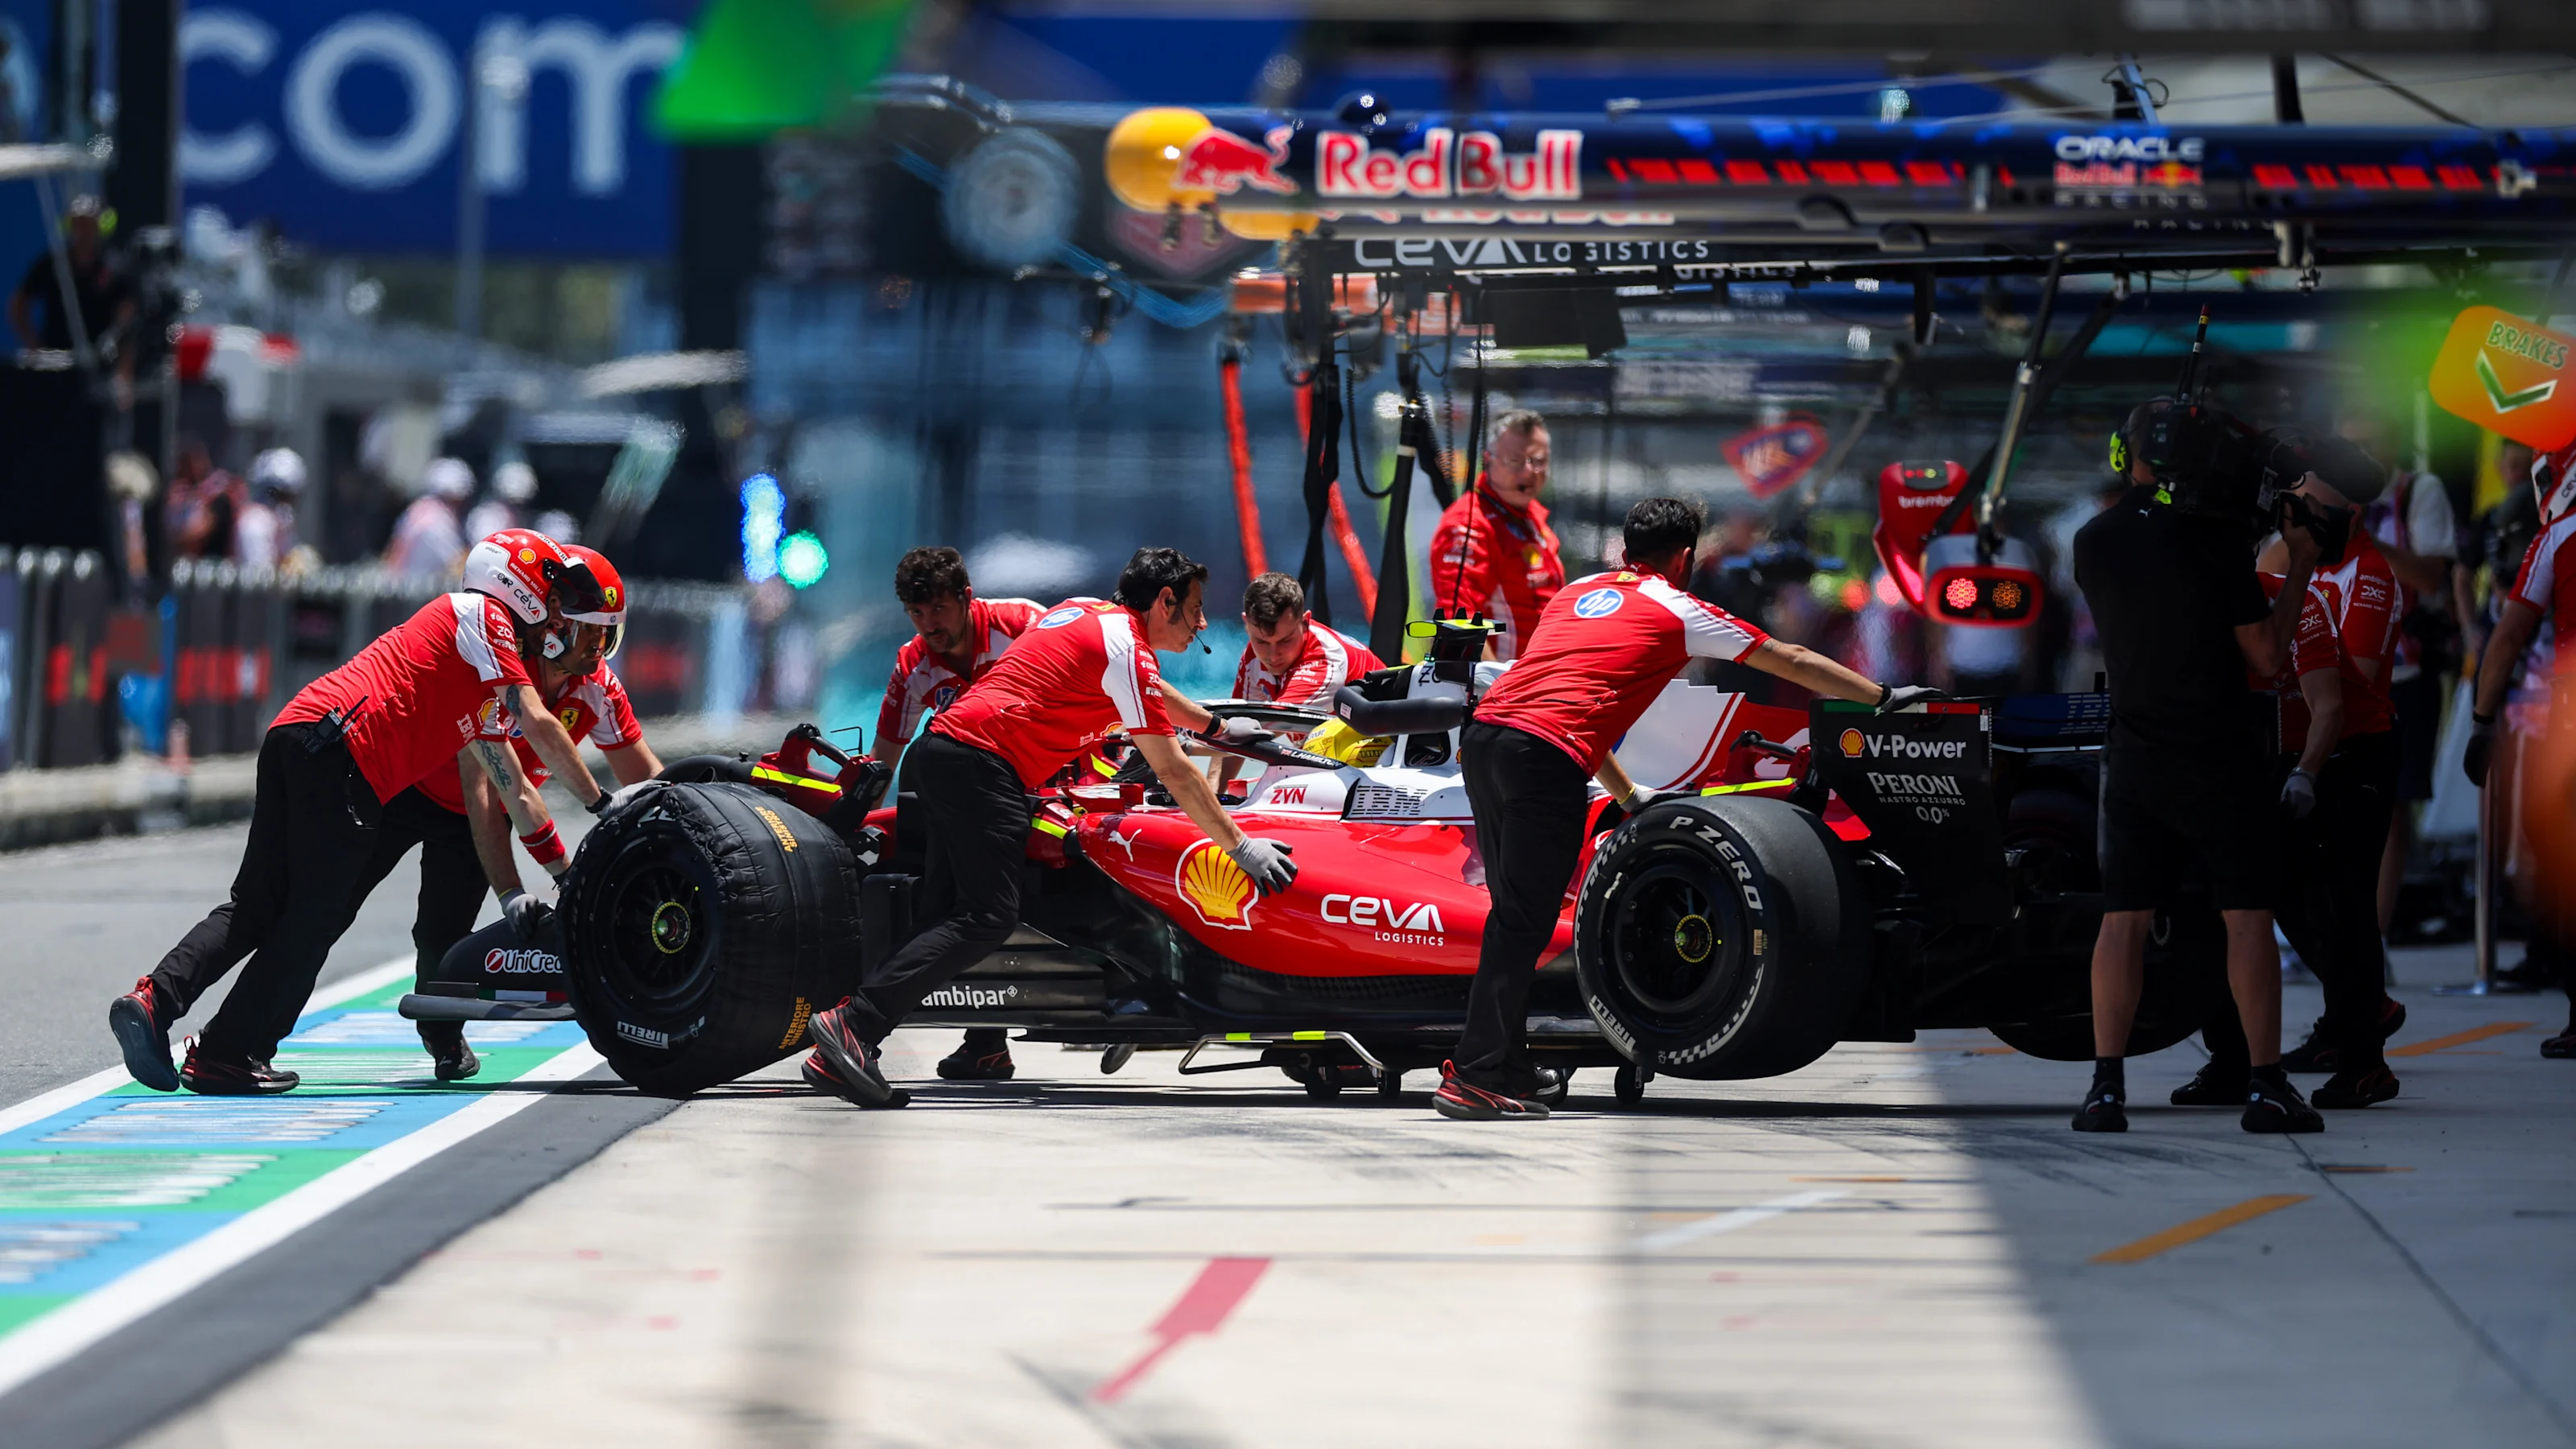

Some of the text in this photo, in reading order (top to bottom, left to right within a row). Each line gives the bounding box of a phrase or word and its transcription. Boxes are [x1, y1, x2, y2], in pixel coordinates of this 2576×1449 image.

[1316, 127, 1583, 200] Red Bull
[2054, 136, 2205, 161] ORACLE
[1534, 241, 1709, 262] LOGISTICS
[2486, 320, 2569, 370] BRAKES
[510, 563, 544, 595] RICHARD MILLE
[2360, 585, 2387, 601] DXC
[1578, 590, 1620, 617] hp
[2298, 613, 2324, 631] DXC
[1865, 733, 1967, 758] V-Power
[1270, 788, 1307, 804] ZYN
[1867, 771, 1963, 796] PERONI
[1350, 784, 1428, 815] IBM
[1879, 795, 1967, 806] NASTRO AZZURRO
[1915, 805, 1951, 824] 0.0%
[755, 806, 794, 852] ANTERIORE
[766, 809, 799, 849] SINISTRO
[1669, 815, 1764, 910] P ZERO
[1320, 894, 1445, 933] CEVA
[1375, 931, 1444, 947] LOGISTICS
[617, 1020, 670, 1050] PIRELLI
[778, 997, 805, 1051] ANTERIORE
[788, 1002, 812, 1047] SINISTRO
[1587, 993, 1637, 1052] PIRELLI
